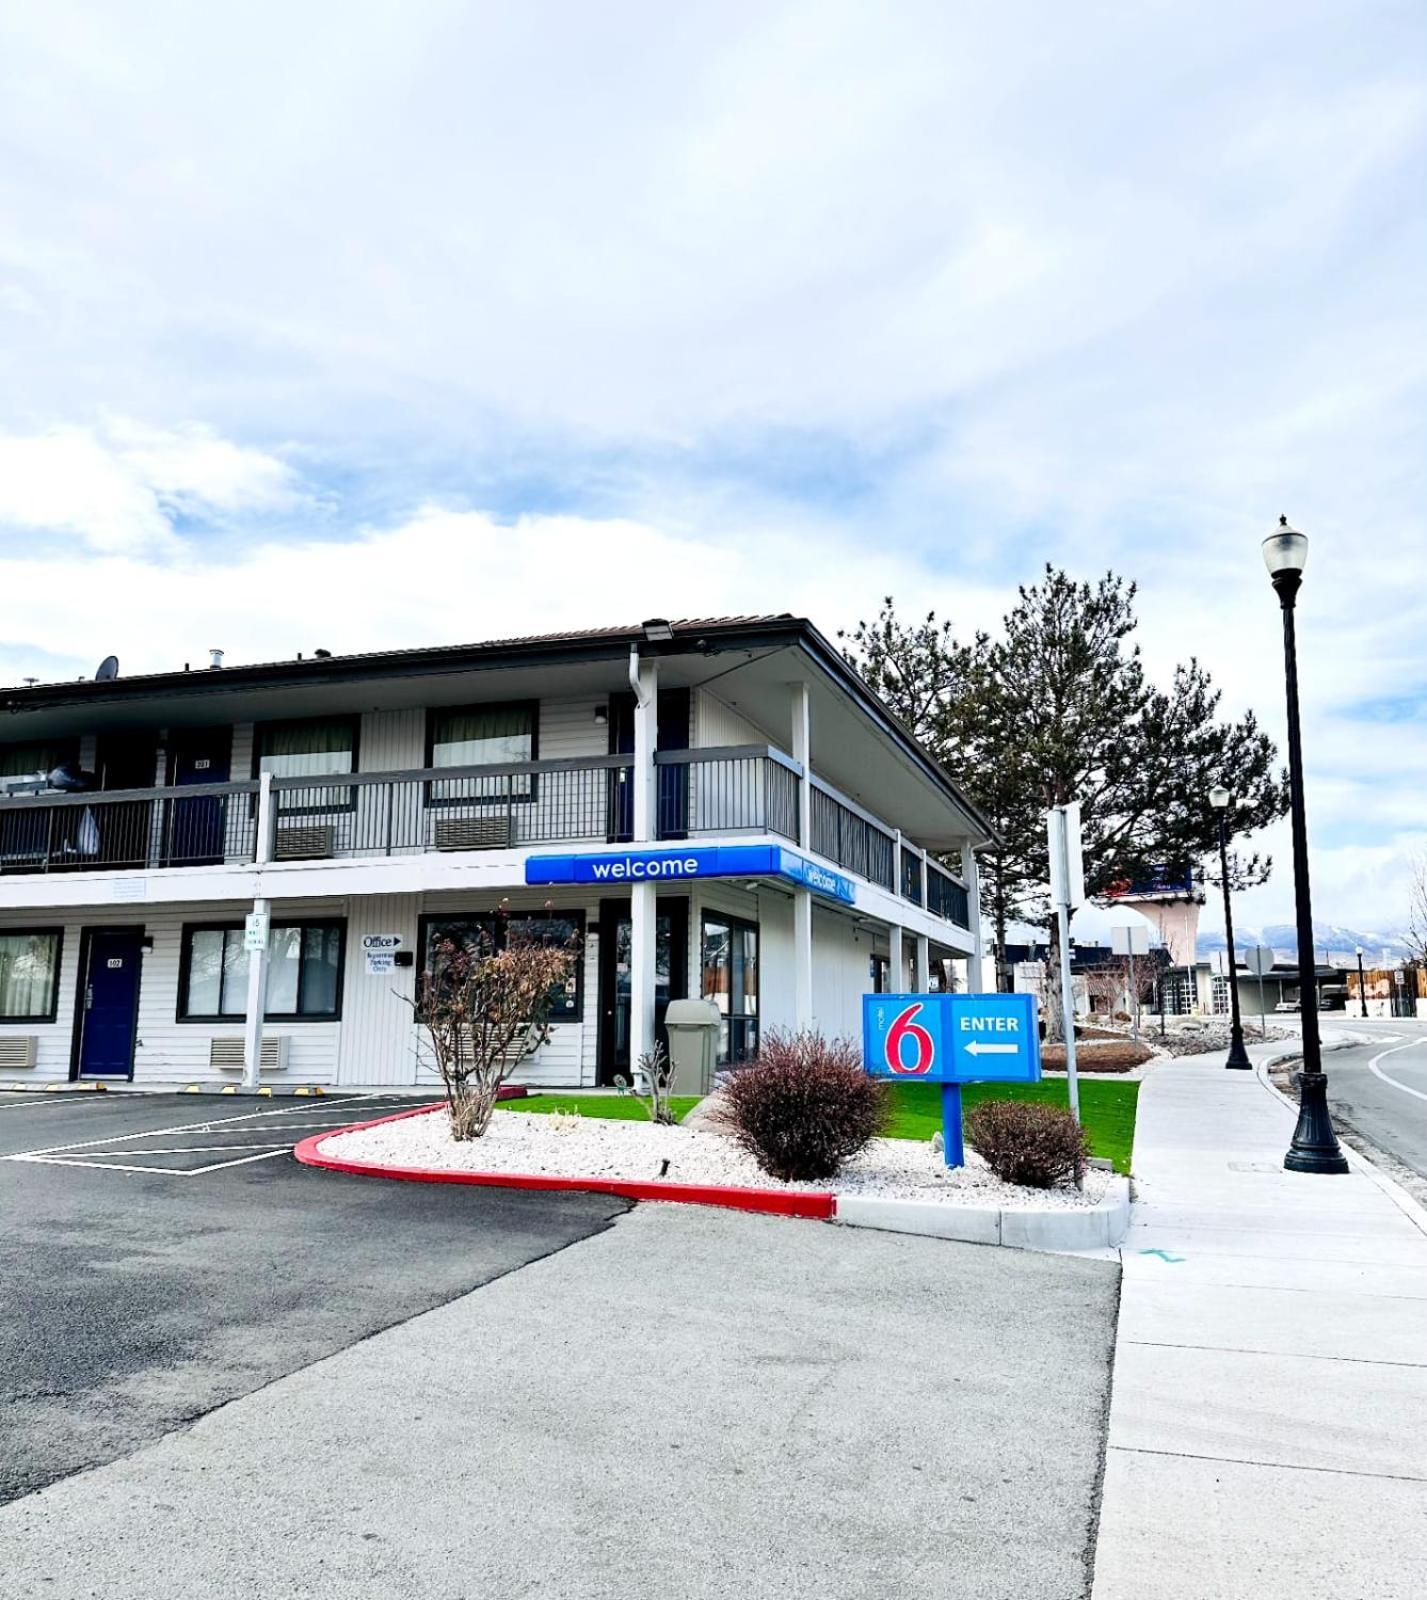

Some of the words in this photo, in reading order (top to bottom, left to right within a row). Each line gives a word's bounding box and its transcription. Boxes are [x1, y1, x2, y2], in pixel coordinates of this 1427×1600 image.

[592, 857, 698, 879] welcome
[363, 936, 392, 948] Office
[960, 1016, 1019, 1031] ENTER
[878, 1006, 886, 1031] motel
[884, 1002, 935, 1074] 6
